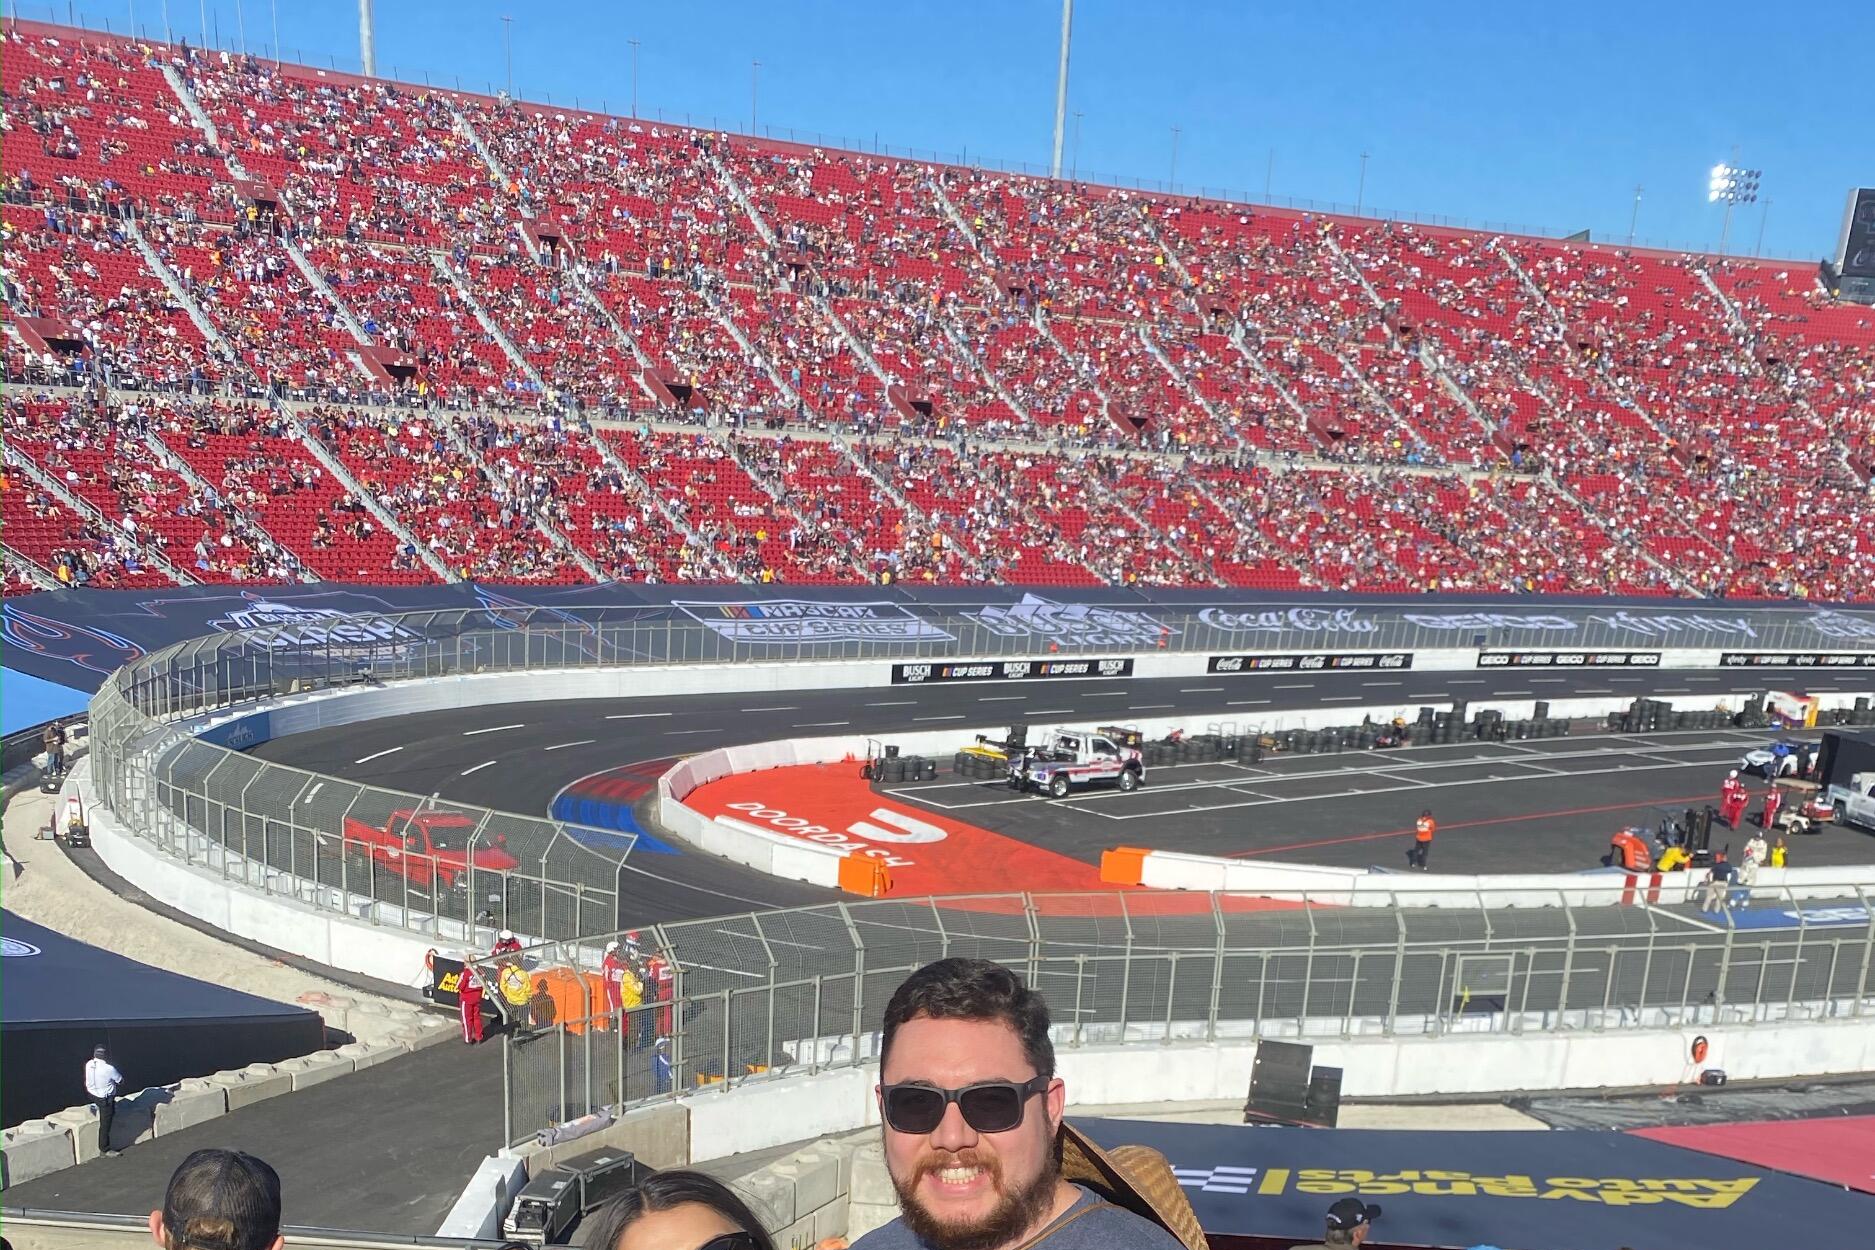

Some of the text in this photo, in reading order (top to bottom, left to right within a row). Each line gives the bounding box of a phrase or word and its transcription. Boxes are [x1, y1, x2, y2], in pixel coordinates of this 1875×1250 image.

[762, 604, 879, 619] NASCAR
[1403, 613, 1578, 629] GEICO
[242, 619, 411, 647] CLASH
[745, 621, 909, 637] CUP SERIES
[1051, 634, 1157, 646] LIGHT
[1098, 660, 1123, 671] BUSCH
[1480, 655, 1509, 664] GEICO
[1556, 655, 1584, 664] GEICO
[1630, 655, 1658, 664] GEICO
[903, 665, 931, 677] BUSCH
[952, 667, 993, 677] CUP SERIES
[1004, 662, 1030, 674] BUSCH
[1050, 664, 1089, 674] CUP SERIES
